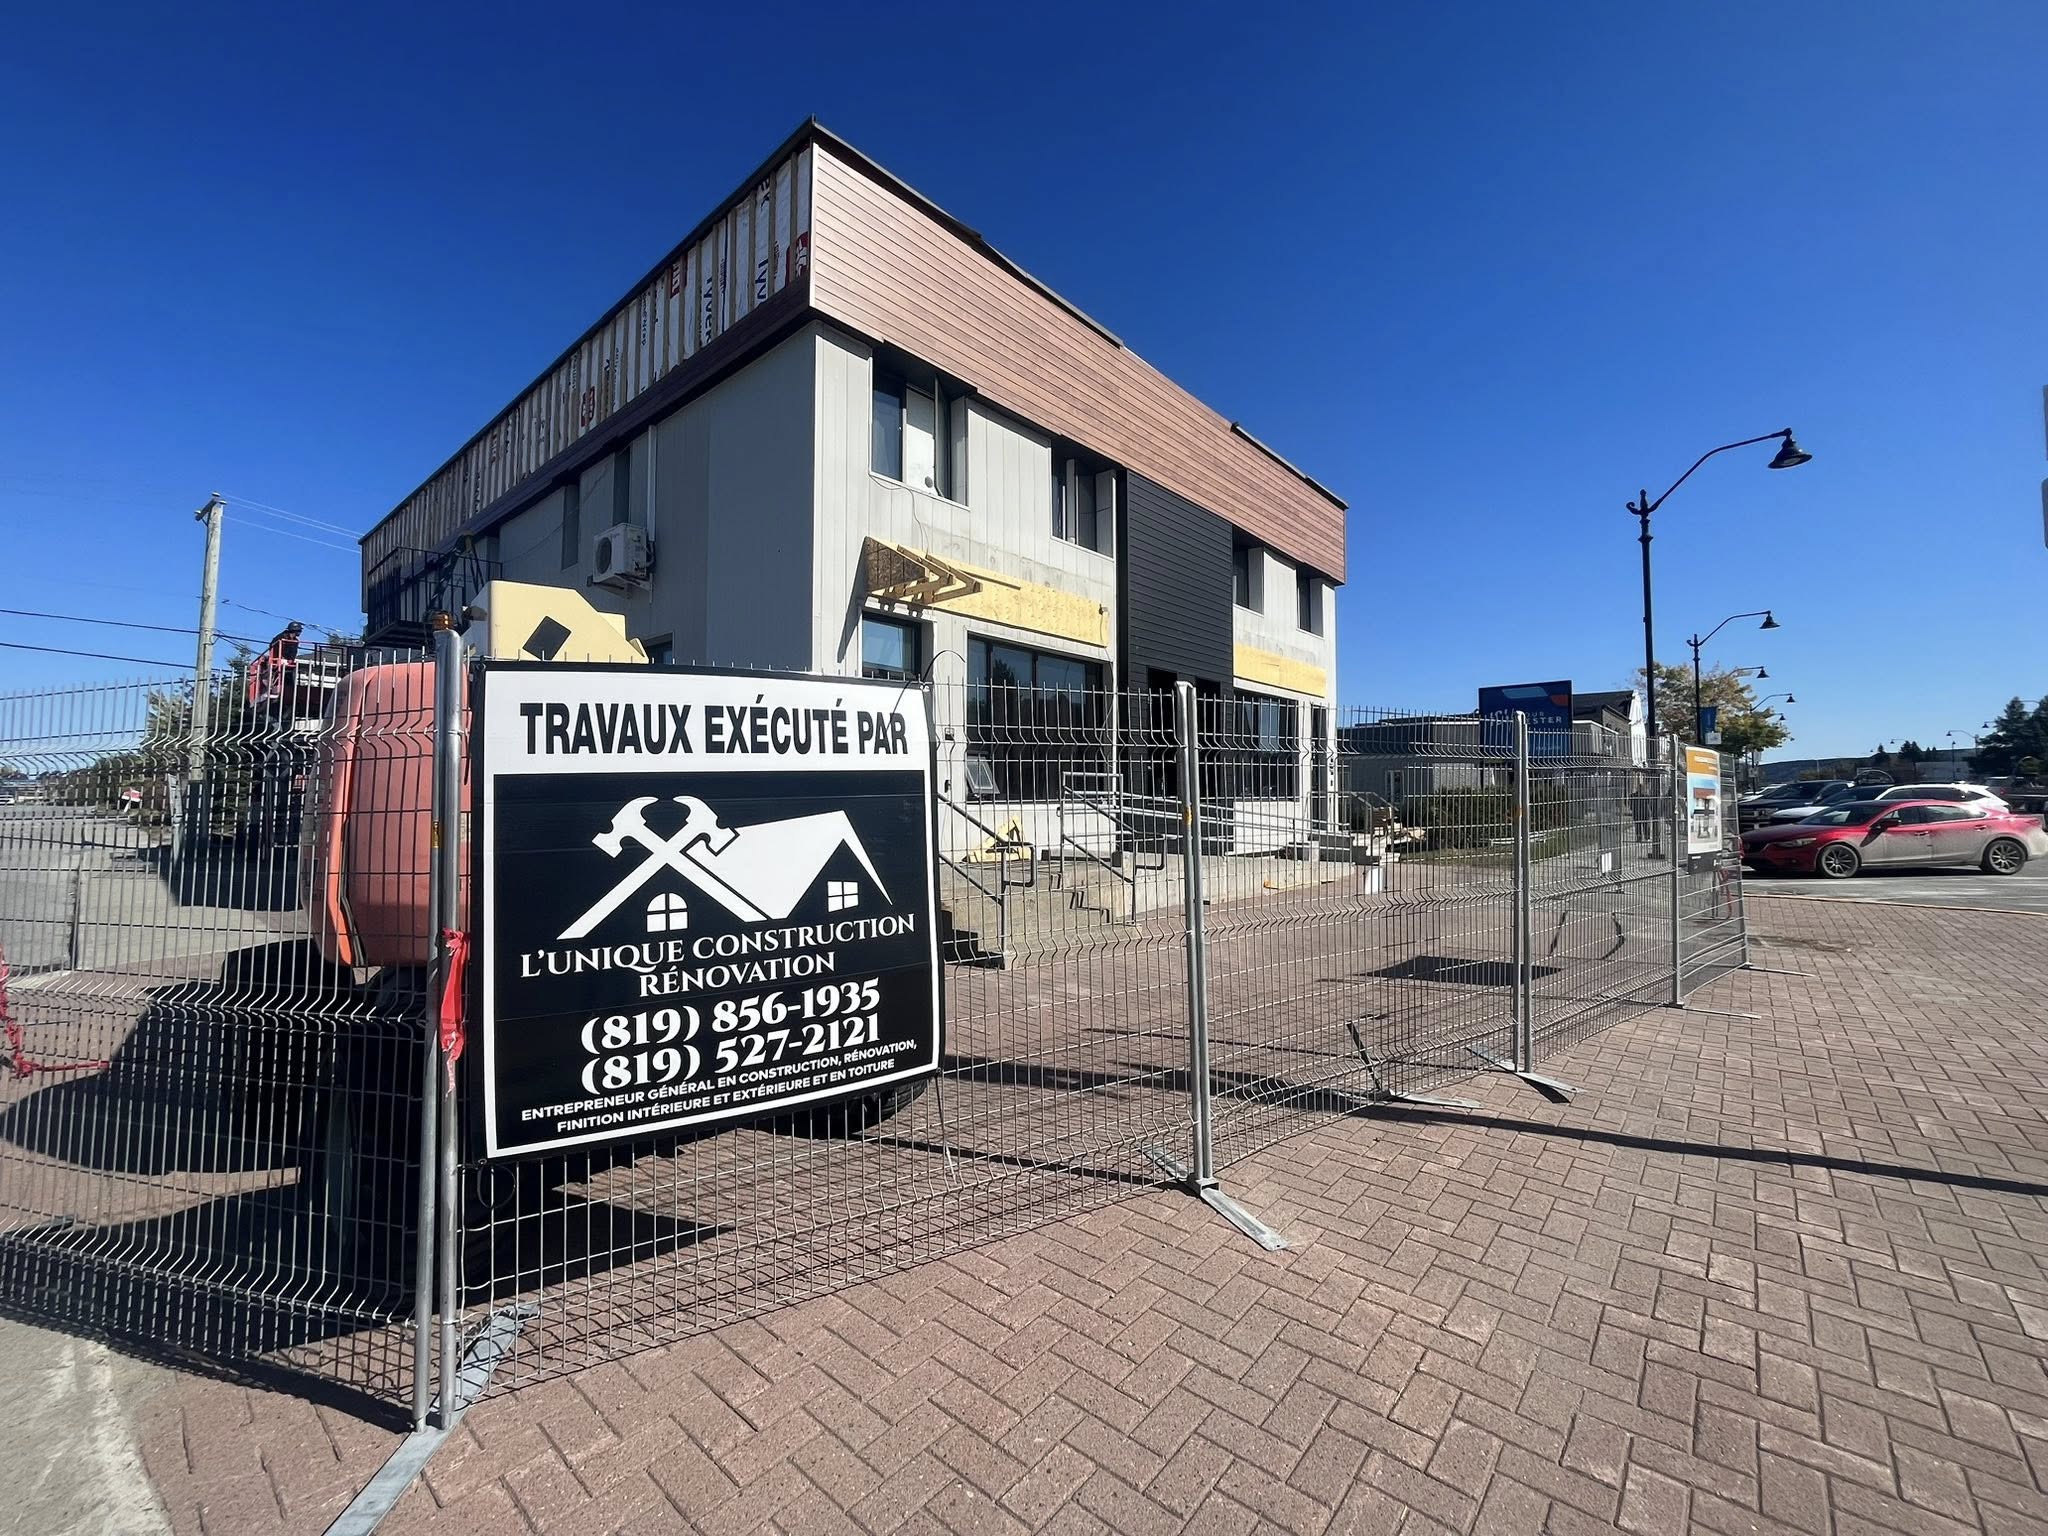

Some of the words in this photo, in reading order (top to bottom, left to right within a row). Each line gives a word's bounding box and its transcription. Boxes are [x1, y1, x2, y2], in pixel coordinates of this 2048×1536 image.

[520, 702, 693, 755] TRAVAUX
[704, 693, 849, 755] EXÉCUTÉ
[856, 710, 909, 755] PAR
[520, 940, 685, 978] L'UNIQUE
[692, 913, 915, 960] CONSTRUCTION
[639, 951, 836, 998] RÉNOVATION
[580, 1005, 701, 1055] (819)
[711, 977, 881, 1034] 856-1935
[580, 1044, 701, 1095] (819)
[714, 1012, 881, 1074] 527-2121
[521, 1090, 645, 1122] ENTREPRENEUR
[647, 1079, 715, 1100] GÉNÉRAL
[717, 1075, 737, 1088] EN
[738, 1055, 843, 1084] CONSTRUCTION,
[844, 1038, 918, 1063] RÉNOVATION,
[556, 1111, 624, 1133] FINITION
[627, 1094, 711, 1121] INTÉRIEURE
[713, 1092, 730, 1106] ET
[732, 1077, 811, 1102] EXTÉRIEURE
[812, 1074, 828, 1086] ET
[829, 1069, 848, 1082] EN
[849, 1058, 895, 1077] TOITURE
